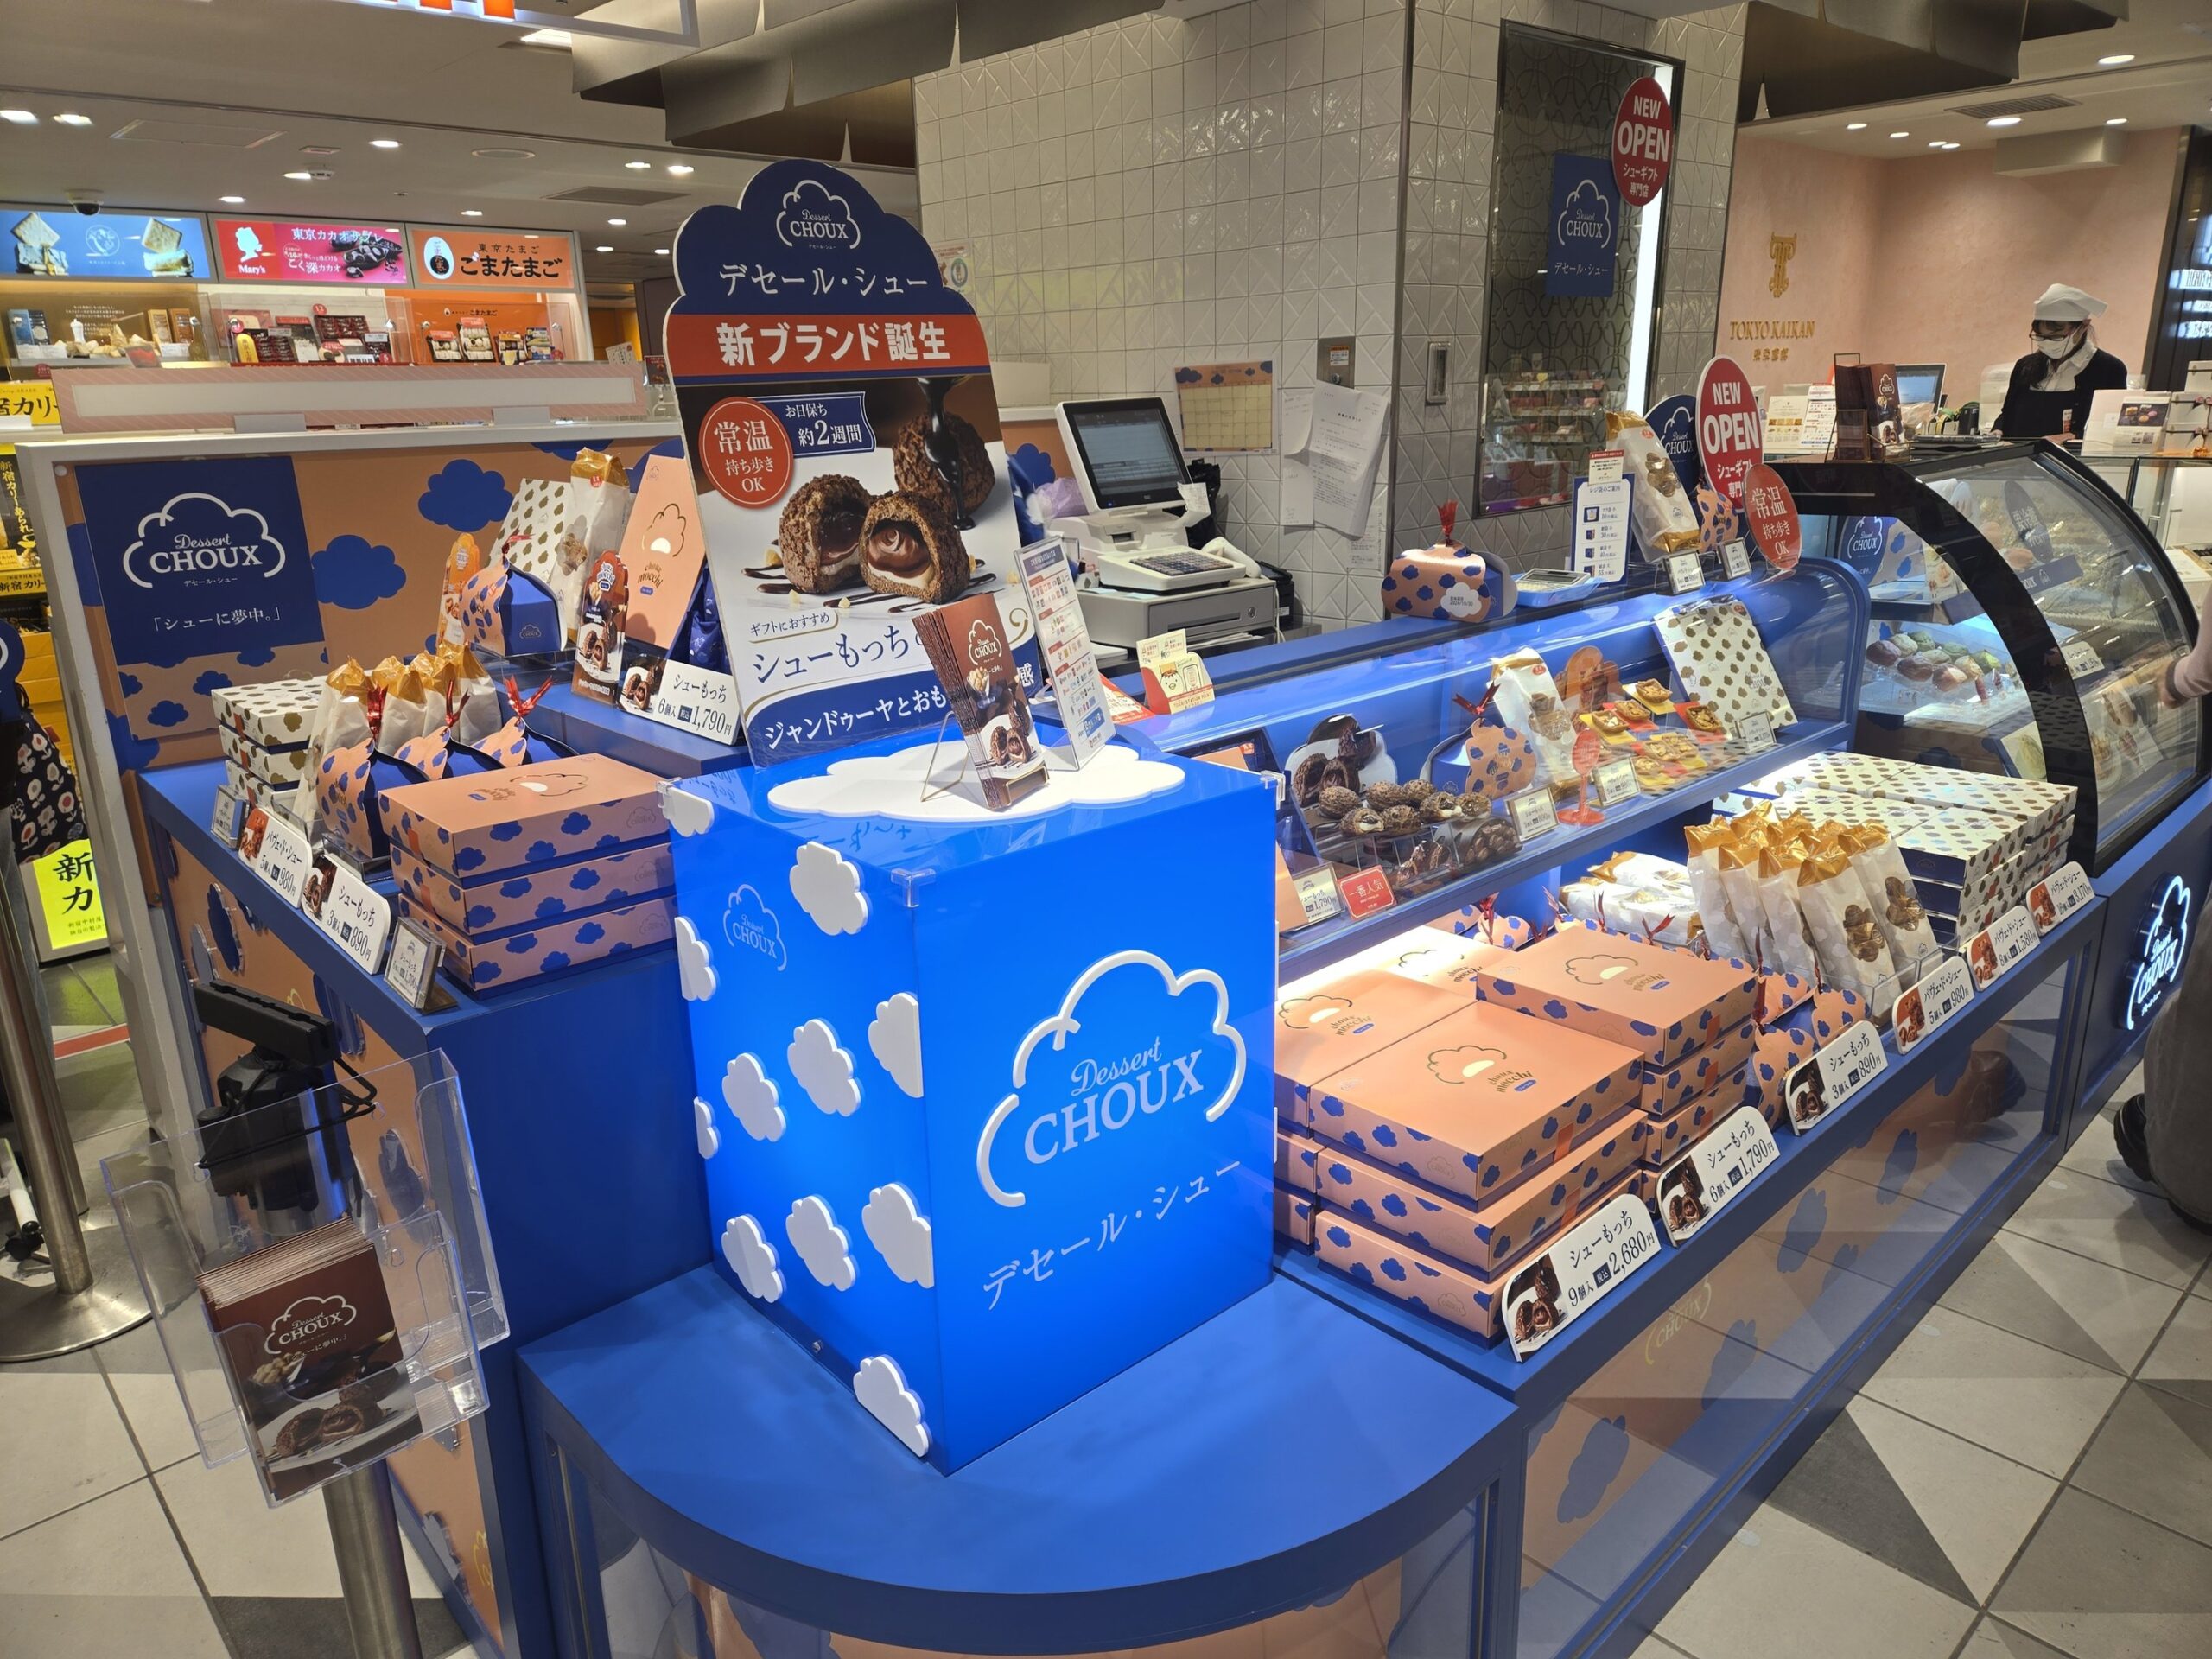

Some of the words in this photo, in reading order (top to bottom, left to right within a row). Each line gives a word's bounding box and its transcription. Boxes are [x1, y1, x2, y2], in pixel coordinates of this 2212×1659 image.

[1633, 95, 1661, 120] NEW
[1617, 120, 1671, 162] OPEN
[1623, 163, 1658, 182] シューギフト
[1629, 181, 1649, 198] 専門店
[802, 208, 831, 223] Dessert
[790, 220, 849, 241] CHOUX
[1566, 220, 1603, 238] CHOUX
[479, 243, 540, 254] 東京たまご
[238, 264, 266, 275] Mary's
[288, 258, 341, 274] こく深カカオ
[1554, 262, 1609, 276] デセール・シュー
[718, 263, 929, 297] デセール・シュー
[1730, 321, 1770, 340] TOKYO
[1770, 321, 1815, 340] KAIKAN
[716, 321, 951, 367] 新ブランド誕生
[0, 395, 58, 418] カリ
[1712, 382, 1741, 406] NEW
[785, 402, 828, 419] お日保ち
[714, 421, 773, 454] 常温
[798, 420, 864, 448] 約2週間
[1702, 410, 1760, 455] OPEN
[724, 455, 775, 478] 持ち歩き
[741, 475, 766, 493] OK
[1751, 485, 1787, 519] 常温
[174, 532, 232, 550] Dessert
[1762, 522, 1791, 540] 持ち歩き
[1853, 537, 1877, 551] CHOUX
[149, 544, 264, 574] CHOUX
[1774, 539, 1789, 556] OK
[184, 577, 238, 587] デセール・シュー
[153, 607, 281, 632] 「シューに夢中。」
[749, 610, 831, 638] ギフトにおすすめ
[753, 624, 910, 684] シューもっち
[974, 642, 998, 659] CHOUX
[673, 674, 727, 703] シューもっち
[1016, 664, 1035, 688] 感
[658, 697, 677, 719] 6個入
[693, 711, 732, 737] 1,790円
[267, 831, 302, 864] パヴェ・ド・シュー
[53, 852, 94, 882] 新
[279, 868, 296, 897] 980円
[1349, 878, 1384, 898] 一番人気
[2050, 871, 2082, 896] パヴェ・ド・シュー
[339, 885, 376, 928] シューもっち
[327, 909, 340, 934] 3個入
[350, 926, 372, 962] 890円
[741, 913, 764, 935] Dessert
[1994, 915, 2027, 945] パヴェ・ド・シュー
[733, 922, 778, 959] CHOUX
[2016, 930, 2037, 956] 1,580円
[2137, 938, 2178, 1004] CHOUX
[1924, 967, 1963, 1002] パヴェ・ド・シュー
[1950, 983, 1970, 1007] 980円
[1335, 1015, 1372, 1037] mocchi
[1828, 1033, 1871, 1072] シューもっち
[1071, 1036, 1162, 1096] Dessert
[1832, 1079, 1850, 1101] 3個入
[1858, 1052, 1882, 1079] 890円
[1495, 1069, 1534, 1094] mocchi
[1024, 1049, 1204, 1165] CHOUX
[1707, 1120, 1755, 1169] シューもっち
[1709, 1179, 1731, 1203] 6個入
[1737, 1137, 1776, 1178] 1,790円
[982, 1160, 1241, 1310] デセール・シュー
[1569, 1210, 1633, 1268] シューもっち
[1568, 1280, 1594, 1307] 9個入
[1592, 1262, 1613, 1289] 税込
[1609, 1230, 1656, 1276] 2,680円
[278, 1311, 344, 1346] CHOUX
[291, 1310, 325, 1329] Dessert
